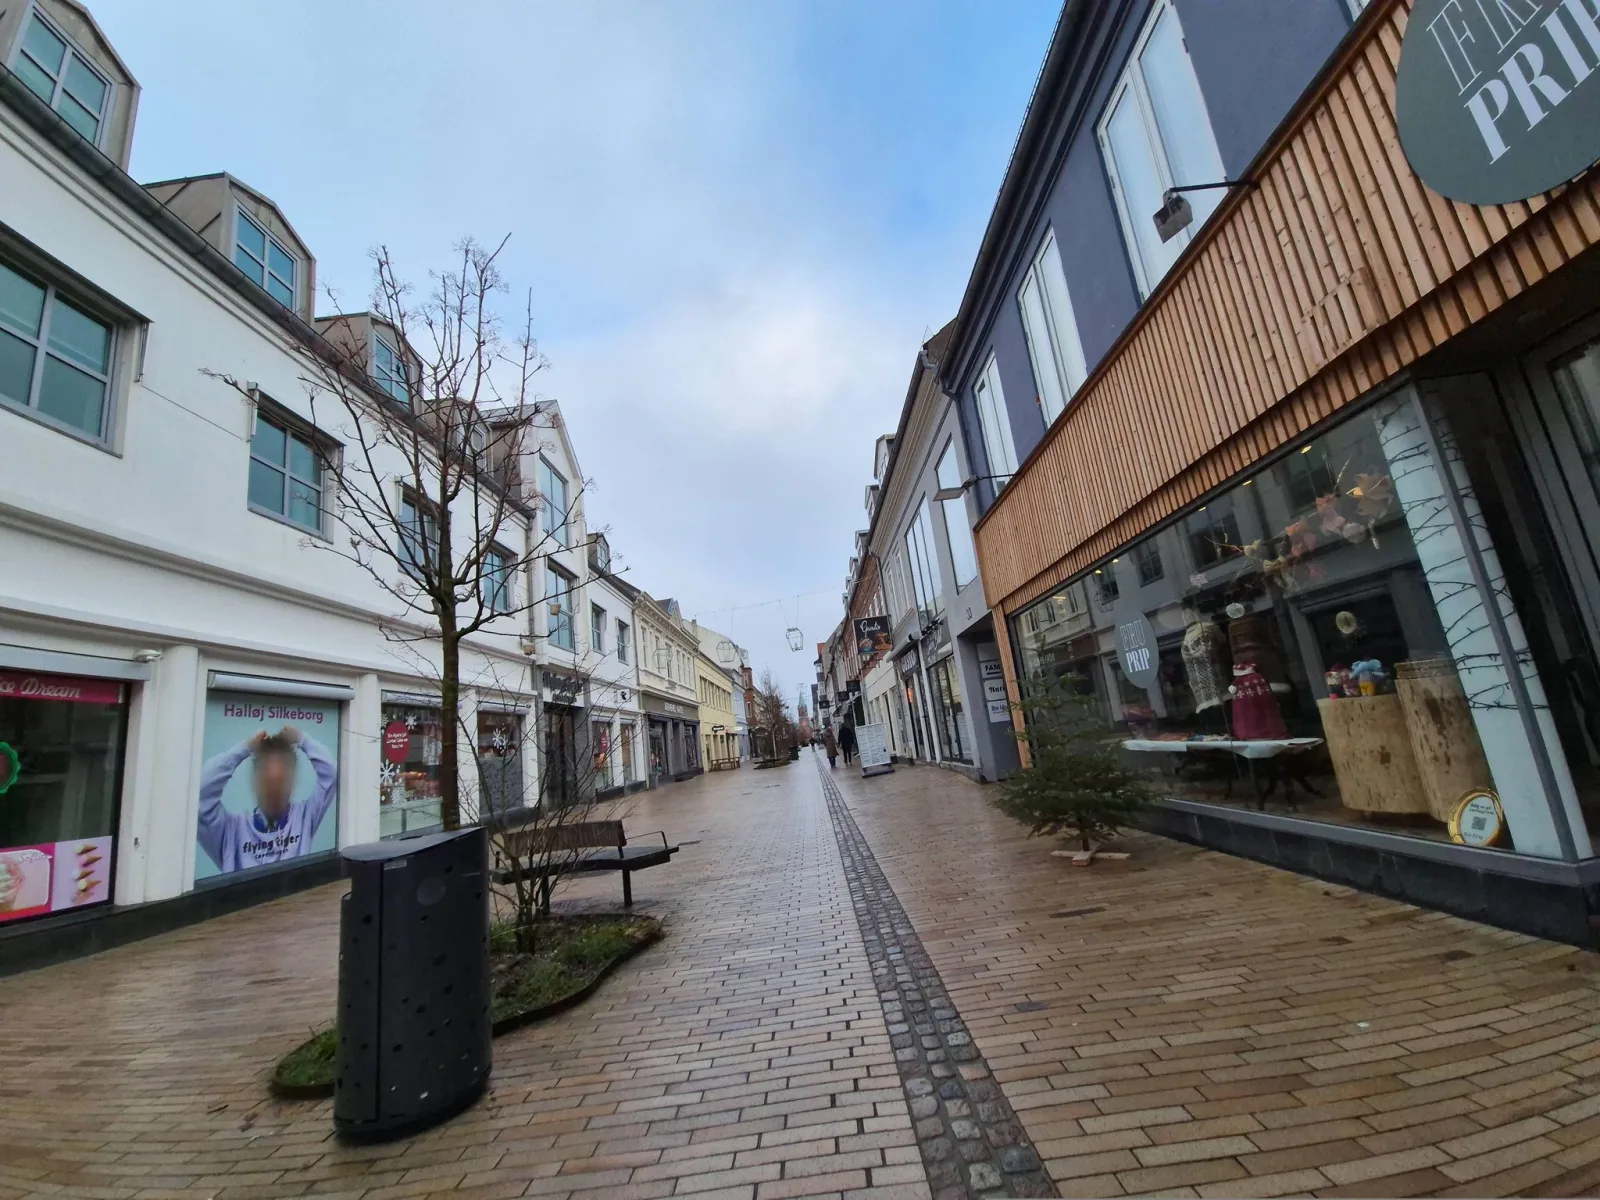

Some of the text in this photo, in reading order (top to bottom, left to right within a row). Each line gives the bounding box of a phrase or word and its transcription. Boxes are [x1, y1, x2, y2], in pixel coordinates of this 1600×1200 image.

[1120, 620, 1146, 651] FRU
[1126, 647, 1150, 673] PRIP
[20, 678, 80, 698] Dream
[224, 704, 324, 724] Halløj Silkeborg
[243, 834, 300, 854] flying tiger
